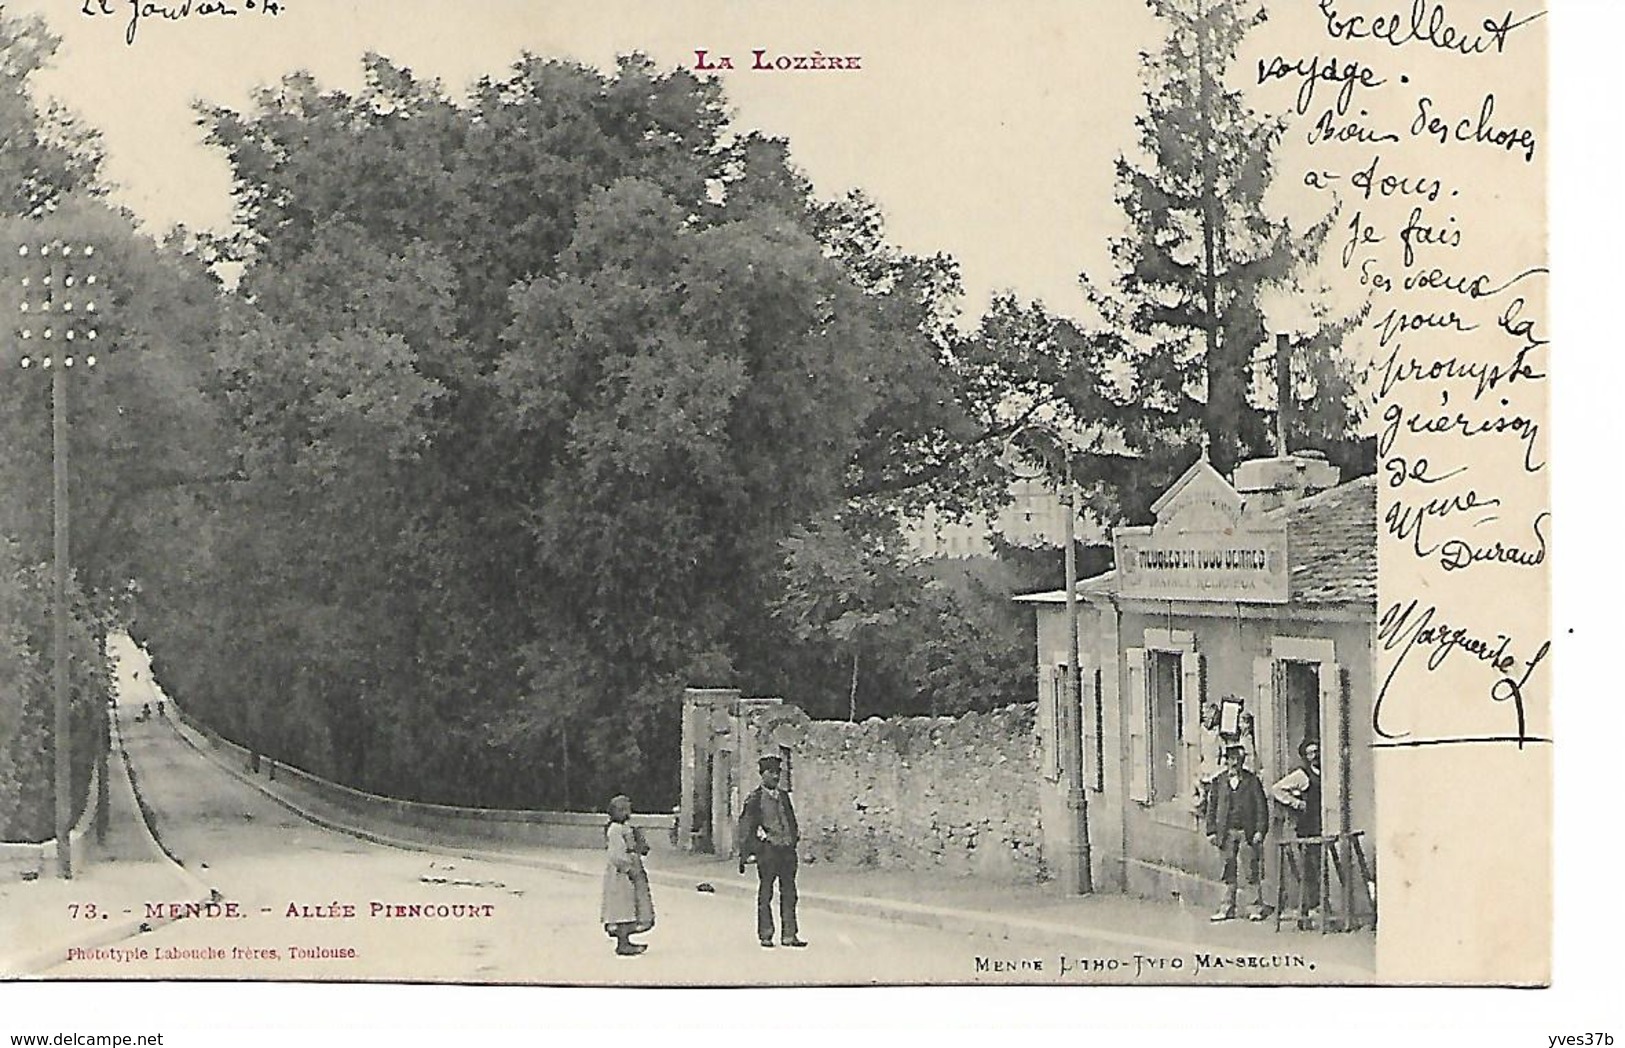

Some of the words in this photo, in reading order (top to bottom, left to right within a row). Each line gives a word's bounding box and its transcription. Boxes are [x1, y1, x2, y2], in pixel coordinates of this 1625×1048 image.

[1400, 208, 1462, 266] fais
[1374, 309, 1480, 347] pour
[1498, 298, 1550, 344] la
[1385, 457, 1467, 488] de
[66, 946, 149, 962] Phototypie
[154, 946, 226, 960] Labouche
[231, 946, 282, 962] frères,
